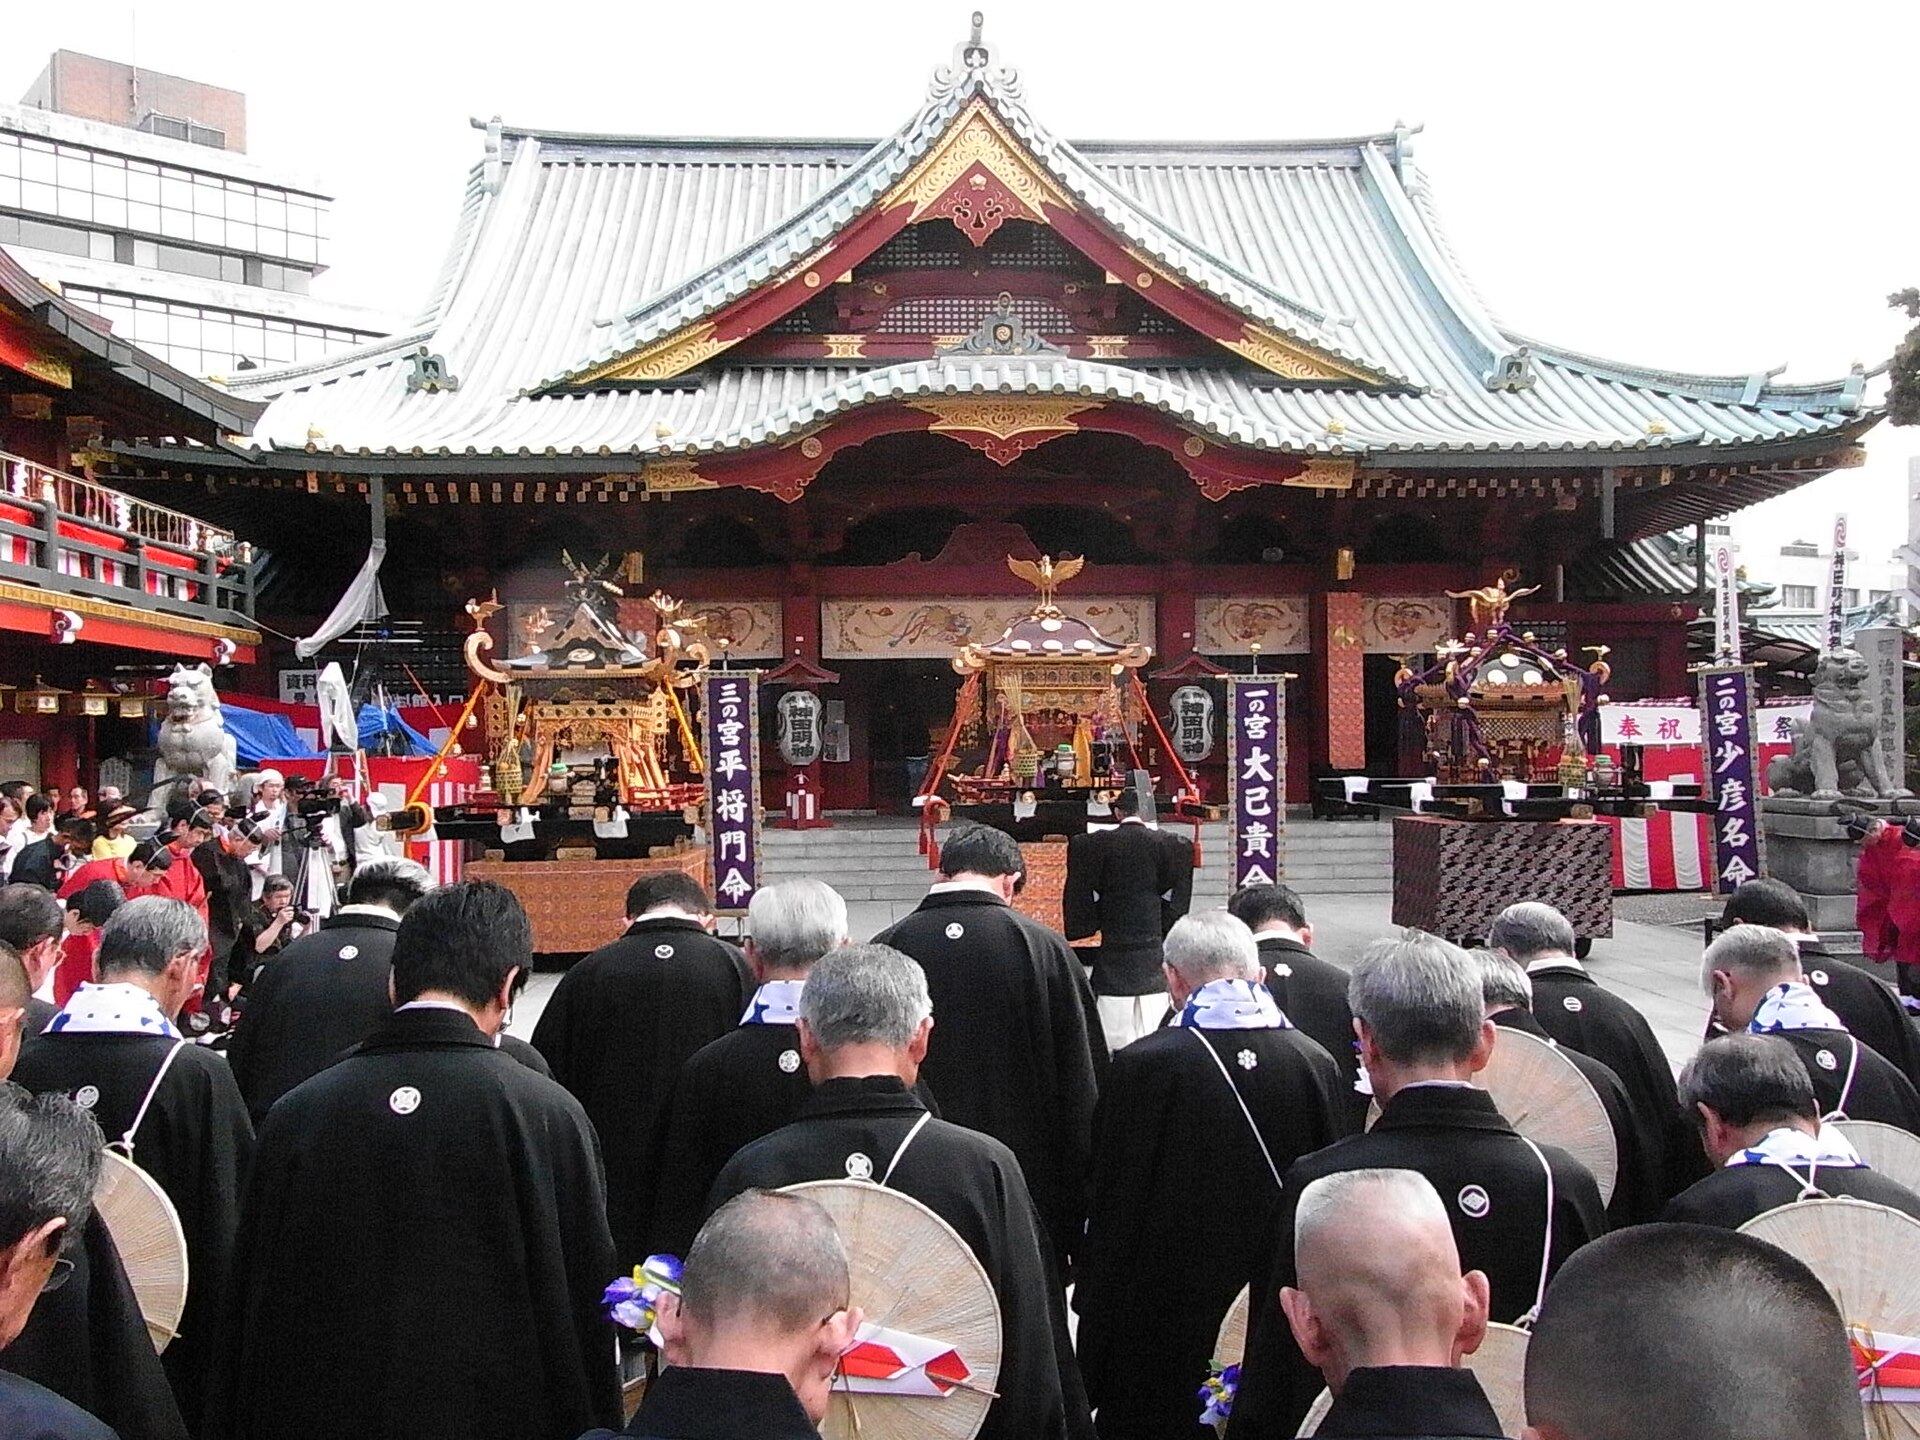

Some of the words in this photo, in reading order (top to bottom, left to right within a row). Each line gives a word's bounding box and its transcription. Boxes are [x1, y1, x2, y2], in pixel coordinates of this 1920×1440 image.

[1617, 714, 1683, 741] 奉祝
[715, 682, 752, 905] 三の宮平将門命
